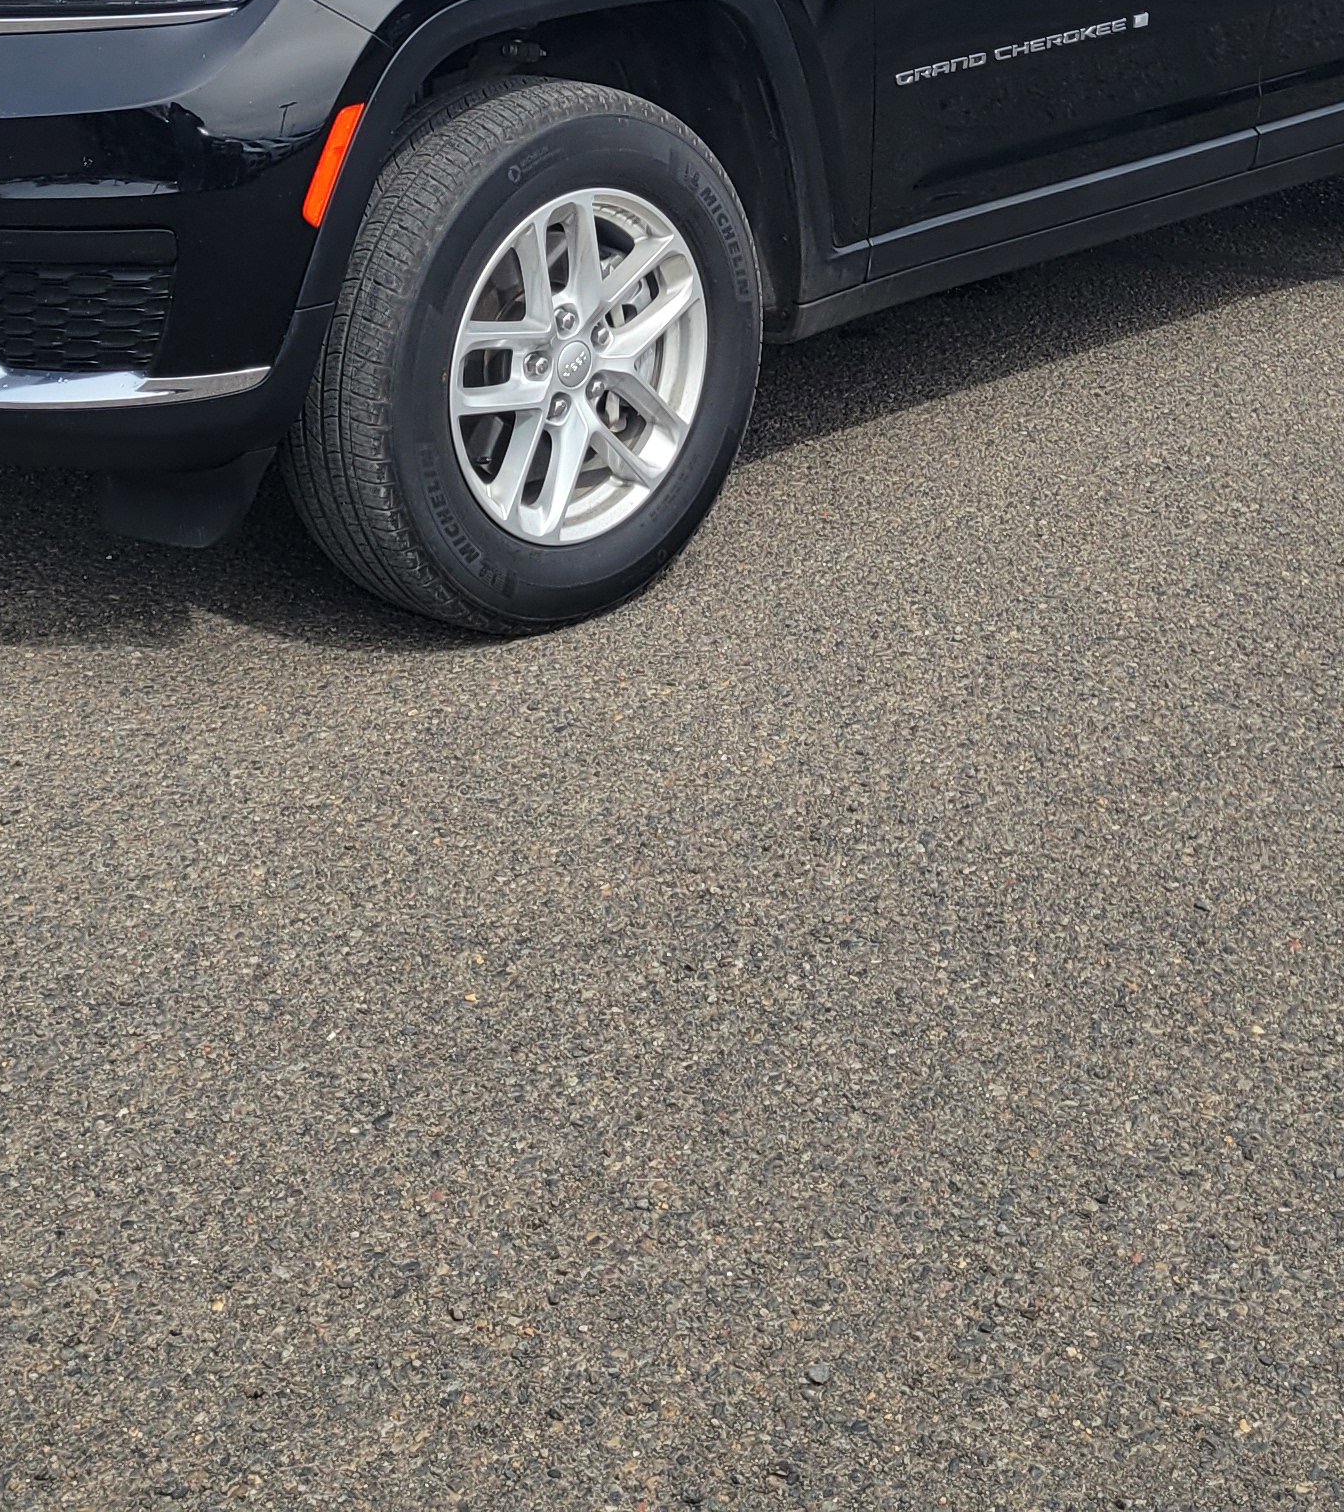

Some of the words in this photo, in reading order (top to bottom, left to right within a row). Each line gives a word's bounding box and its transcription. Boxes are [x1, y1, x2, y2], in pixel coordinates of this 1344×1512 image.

[895, 52, 987, 87] GRAND
[994, 17, 1128, 62] CHEROKEE
[699, 185, 750, 296] MICHELIN
